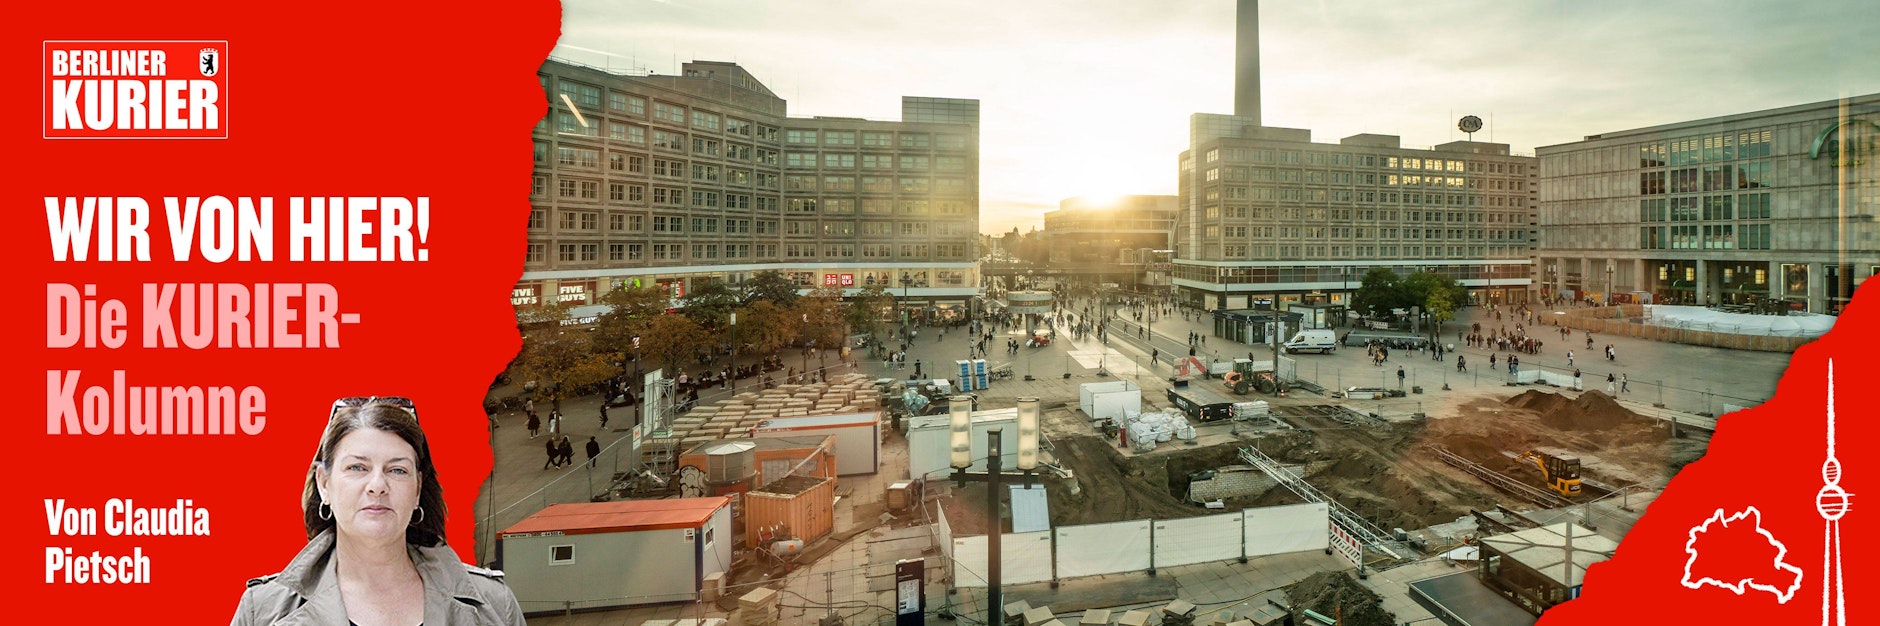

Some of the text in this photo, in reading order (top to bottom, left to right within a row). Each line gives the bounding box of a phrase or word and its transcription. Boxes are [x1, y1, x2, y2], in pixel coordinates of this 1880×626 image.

[560, 285, 584, 294] FIVE
[557, 293, 586, 302] GUYS
[579, 315, 600, 324] GUY
